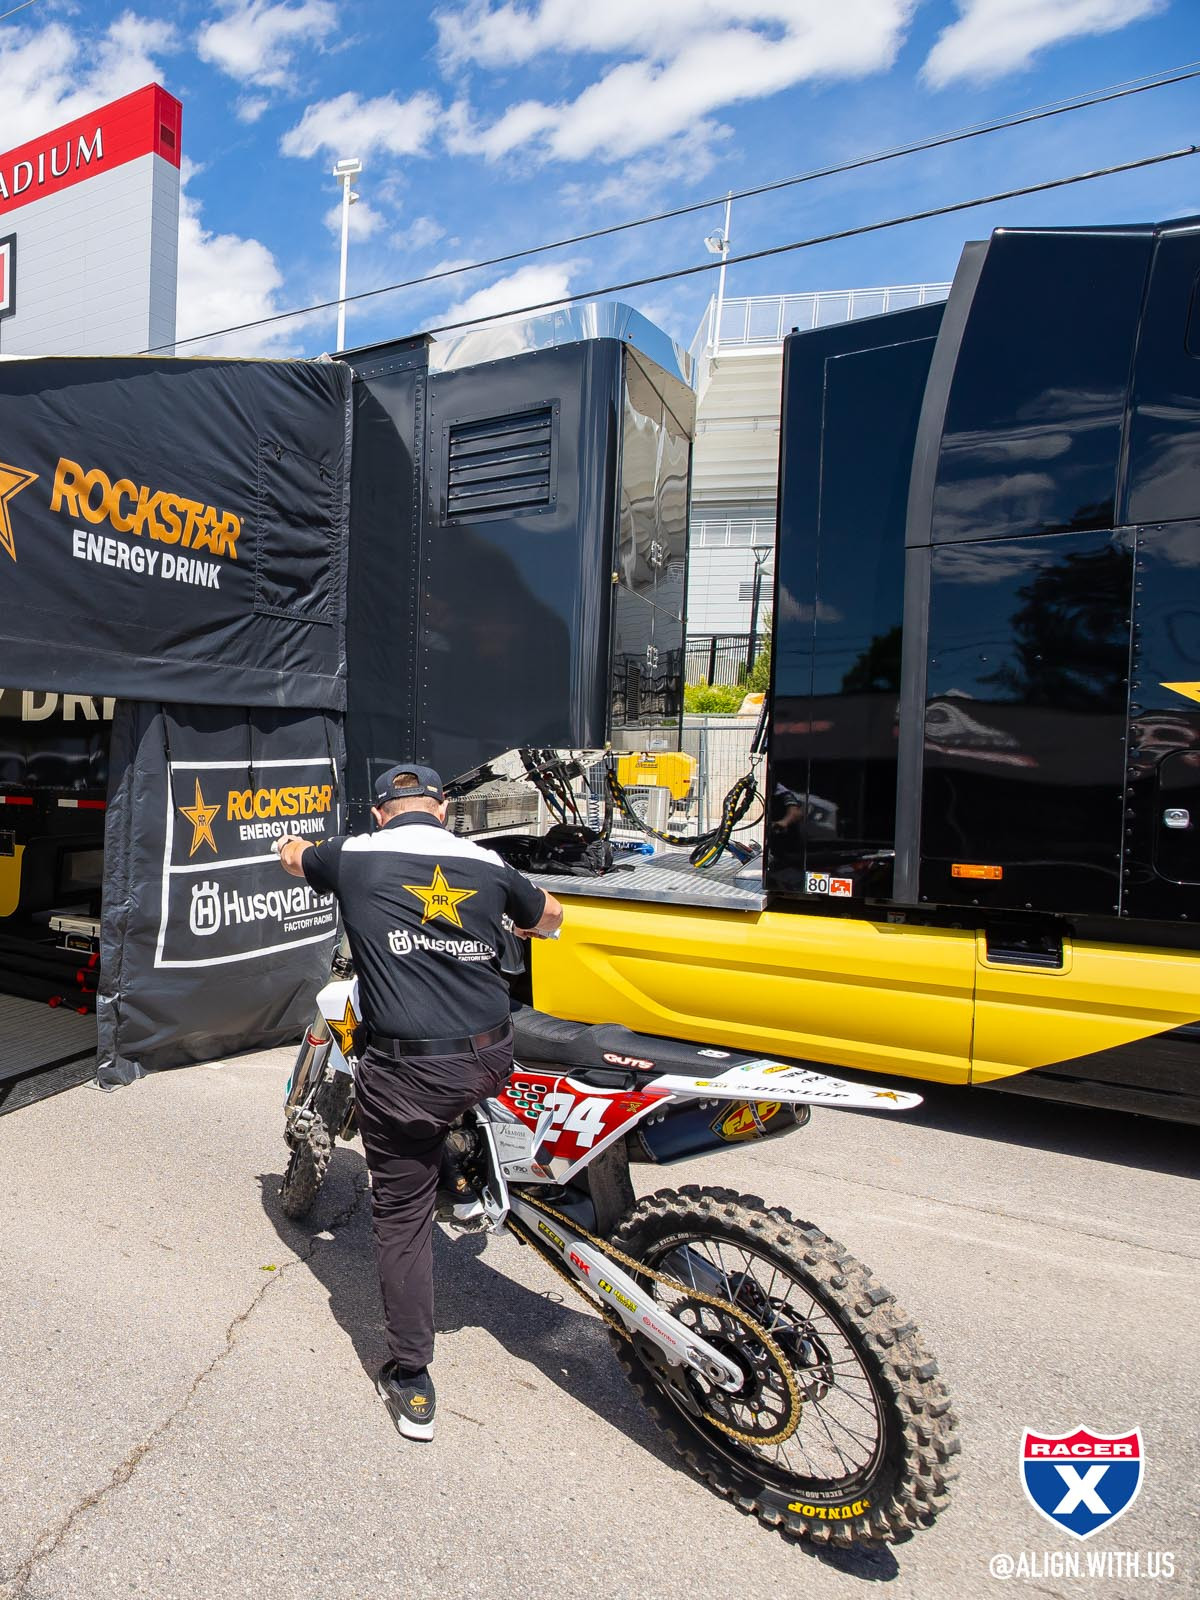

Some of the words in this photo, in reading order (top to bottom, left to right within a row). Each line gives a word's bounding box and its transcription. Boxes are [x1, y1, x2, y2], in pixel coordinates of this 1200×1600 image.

[50, 457, 240, 560] ROCKSTAR
[72, 529, 159, 576] ENERGY
[161, 552, 221, 590] DRINK
[226, 785, 332, 821] ROCKSTAR
[239, 821, 290, 841] ENERGY
[291, 817, 325, 834] DRINK
[809, 878, 827, 892] 80
[284, 917, 313, 933] FACTORY
[313, 913, 333, 927] RACING
[603, 1053, 655, 1070] GUTS
[751, 1086, 850, 1098] DUNLOP
[534, 1092, 614, 1149] 24
[539, 1222, 565, 1249] EXCEL
[569, 1251, 591, 1276] RK
[650, 1323, 677, 1345] brembo
[787, 1500, 865, 1520] DUNLOP
